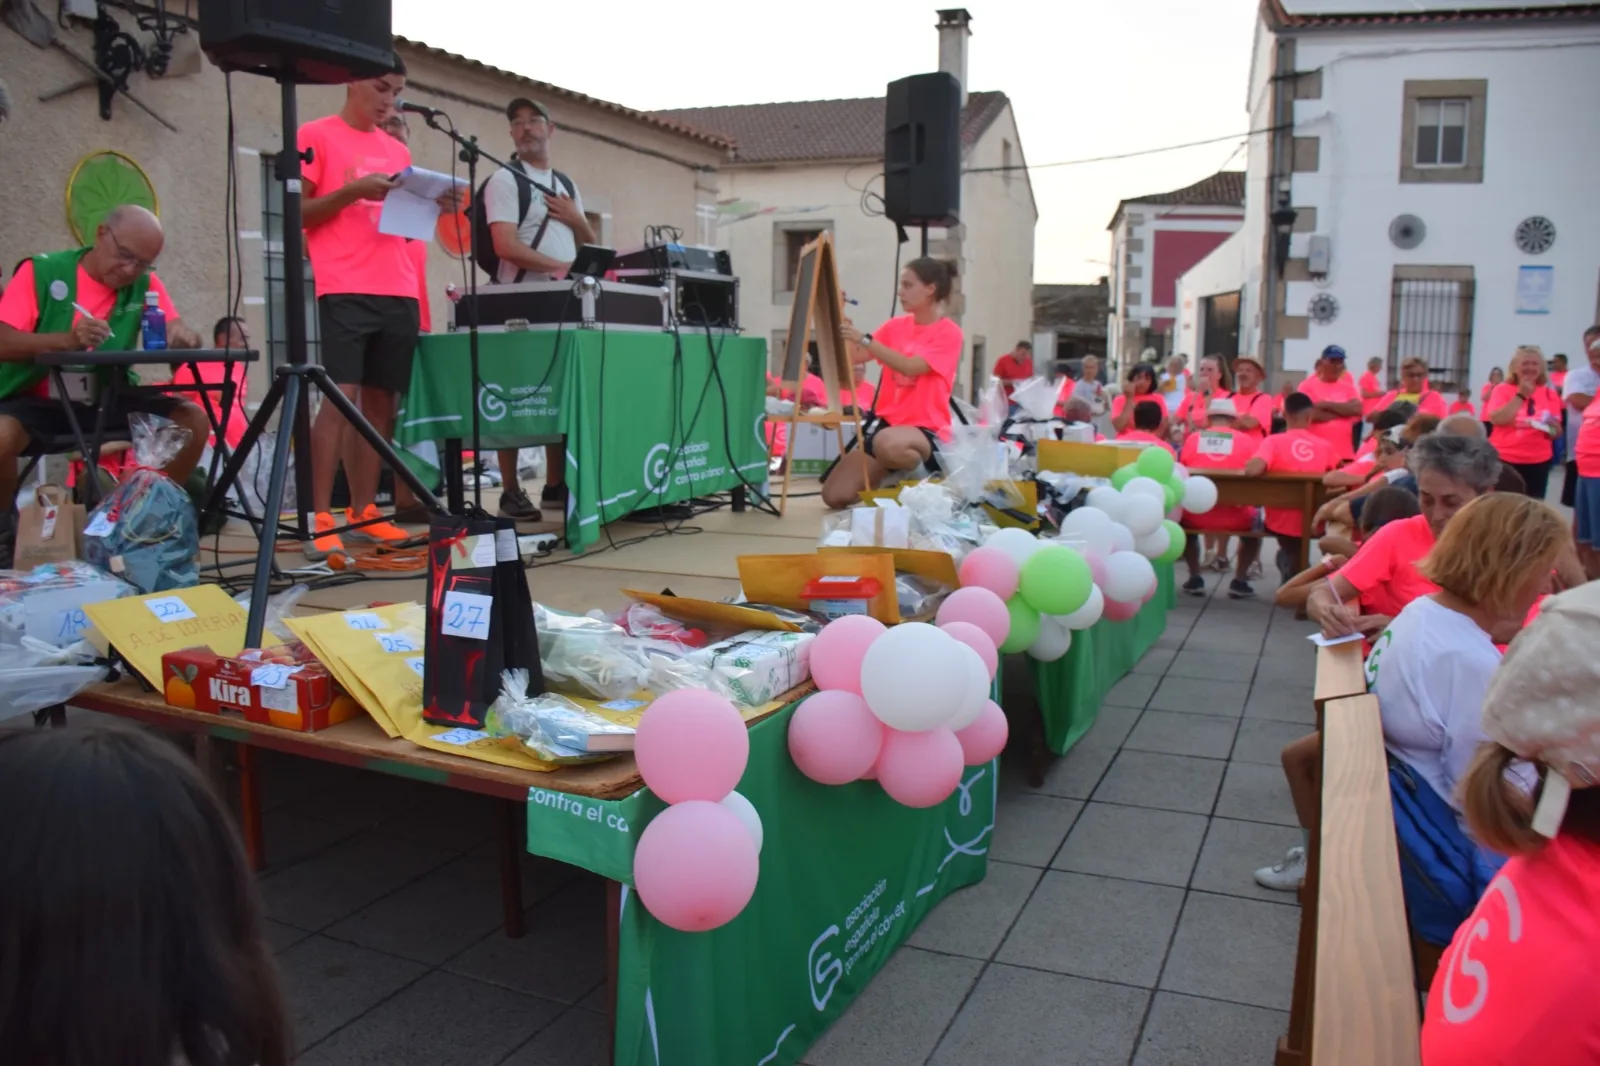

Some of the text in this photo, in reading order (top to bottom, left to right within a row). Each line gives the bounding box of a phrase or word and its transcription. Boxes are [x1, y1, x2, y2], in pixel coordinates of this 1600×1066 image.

[155, 602, 188, 618] 22
[447, 602, 485, 632] 27
[58, 611, 87, 637] 18
[153, 627, 175, 643] DE
[381, 637, 413, 652] 25
[208, 676, 252, 708] Kira
[527, 786, 582, 816] contra
[586, 805, 604, 823] el
